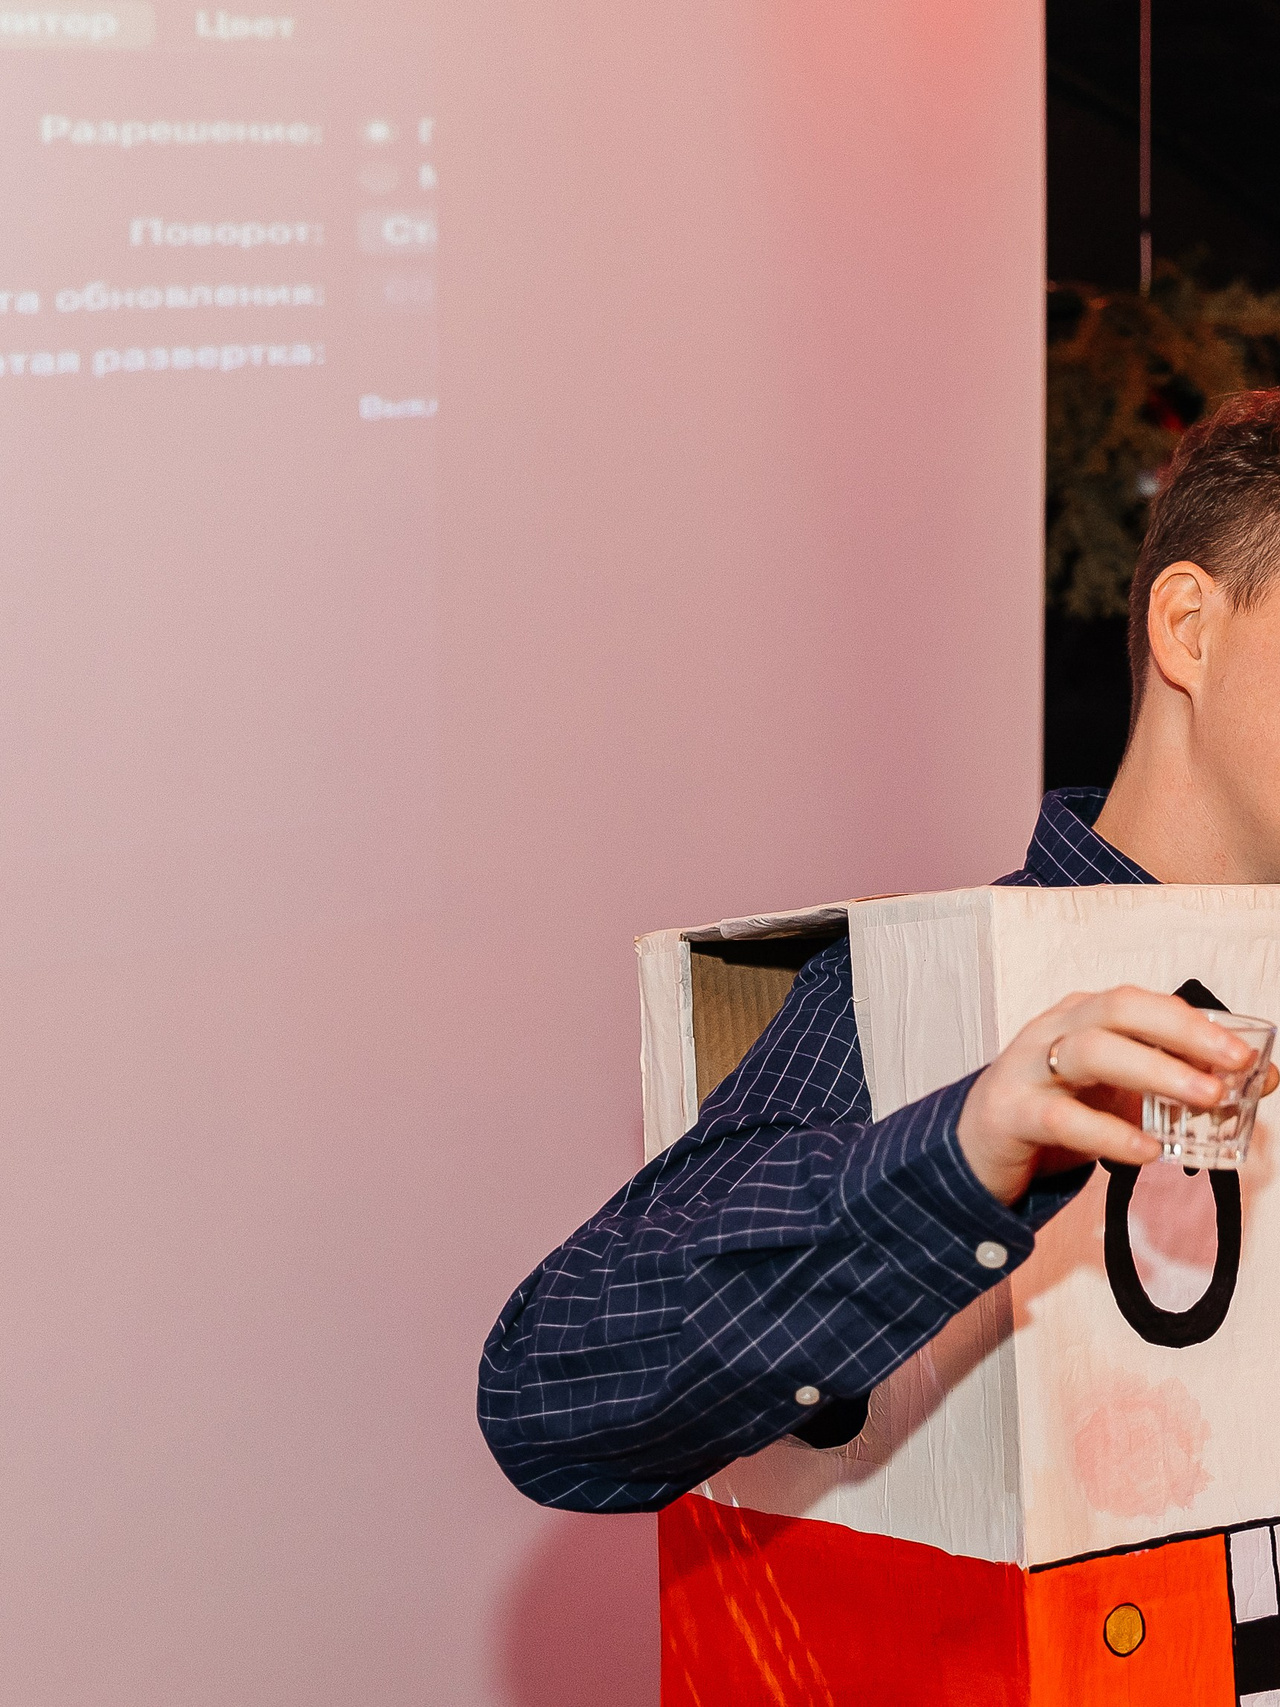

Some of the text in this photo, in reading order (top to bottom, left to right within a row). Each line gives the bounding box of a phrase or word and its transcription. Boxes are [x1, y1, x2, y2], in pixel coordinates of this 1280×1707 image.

[195, 9, 296, 41] Цвет
[40, 114, 323, 148] Разрешение:
[129, 216, 324, 248] Поворот:
[55, 281, 325, 312] обновления:
[92, 342, 325, 378] развертка:
